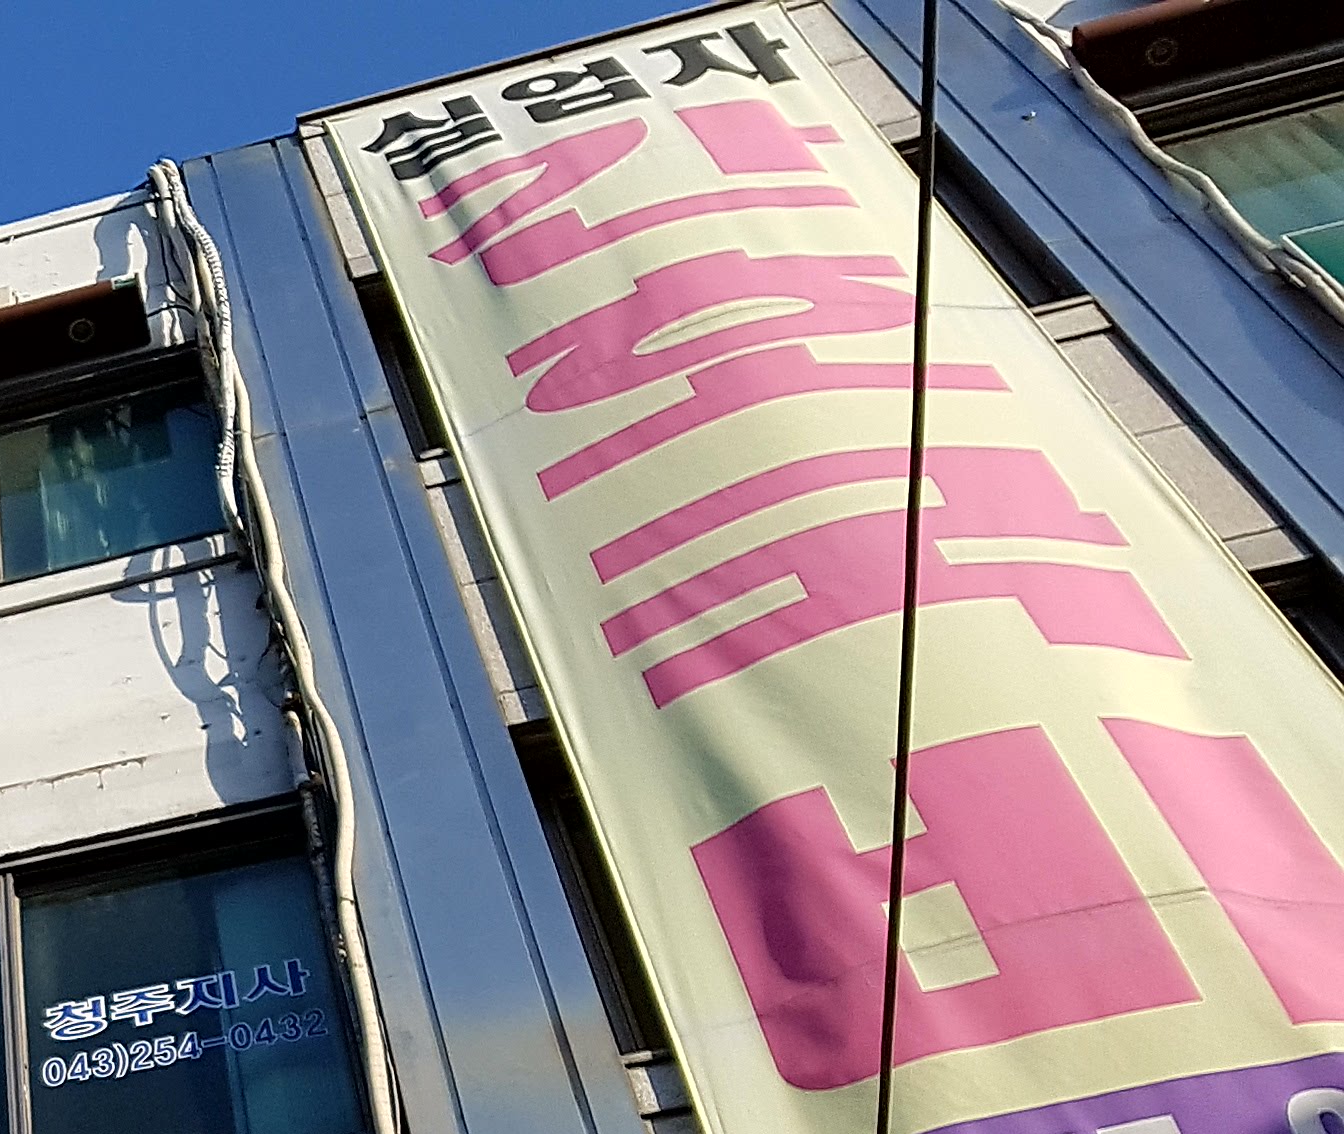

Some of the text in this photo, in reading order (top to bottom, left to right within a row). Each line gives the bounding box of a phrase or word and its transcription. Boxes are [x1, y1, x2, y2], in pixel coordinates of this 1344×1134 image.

[361, 21, 800, 181] 실업자
[42, 958, 311, 1041] 청주지사
[41, 1008, 328, 1088] 043)254-0432
